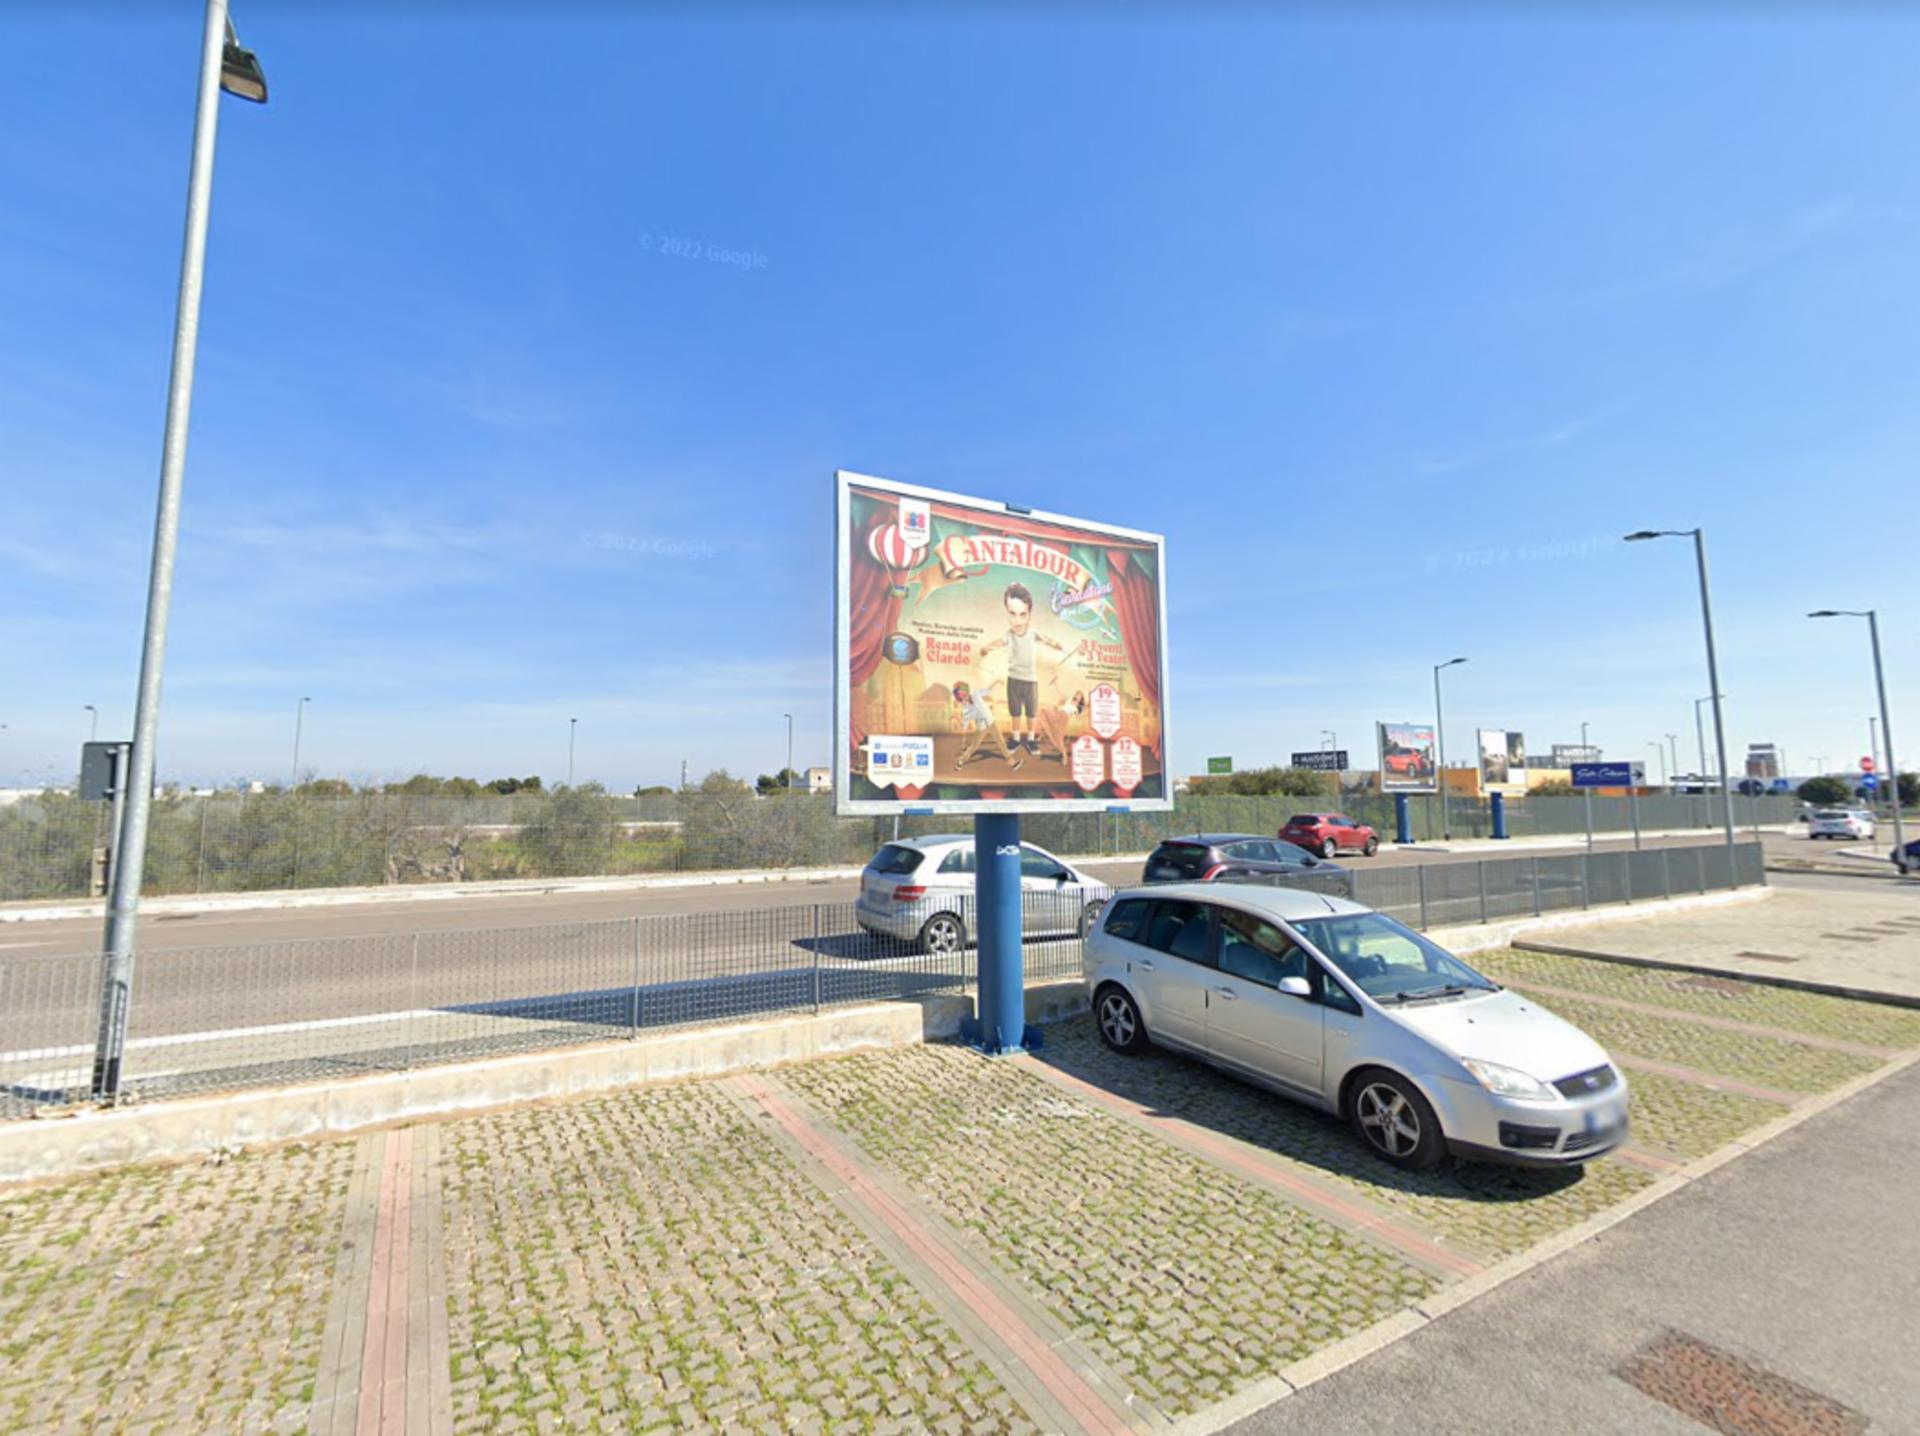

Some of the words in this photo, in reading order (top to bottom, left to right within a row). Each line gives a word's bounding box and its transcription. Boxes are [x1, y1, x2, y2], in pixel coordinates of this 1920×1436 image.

[926, 636, 972, 653] Renato
[1098, 687, 1112, 698] 19
[1082, 738, 1092, 749] 2
[1119, 739, 1132, 750] 17
